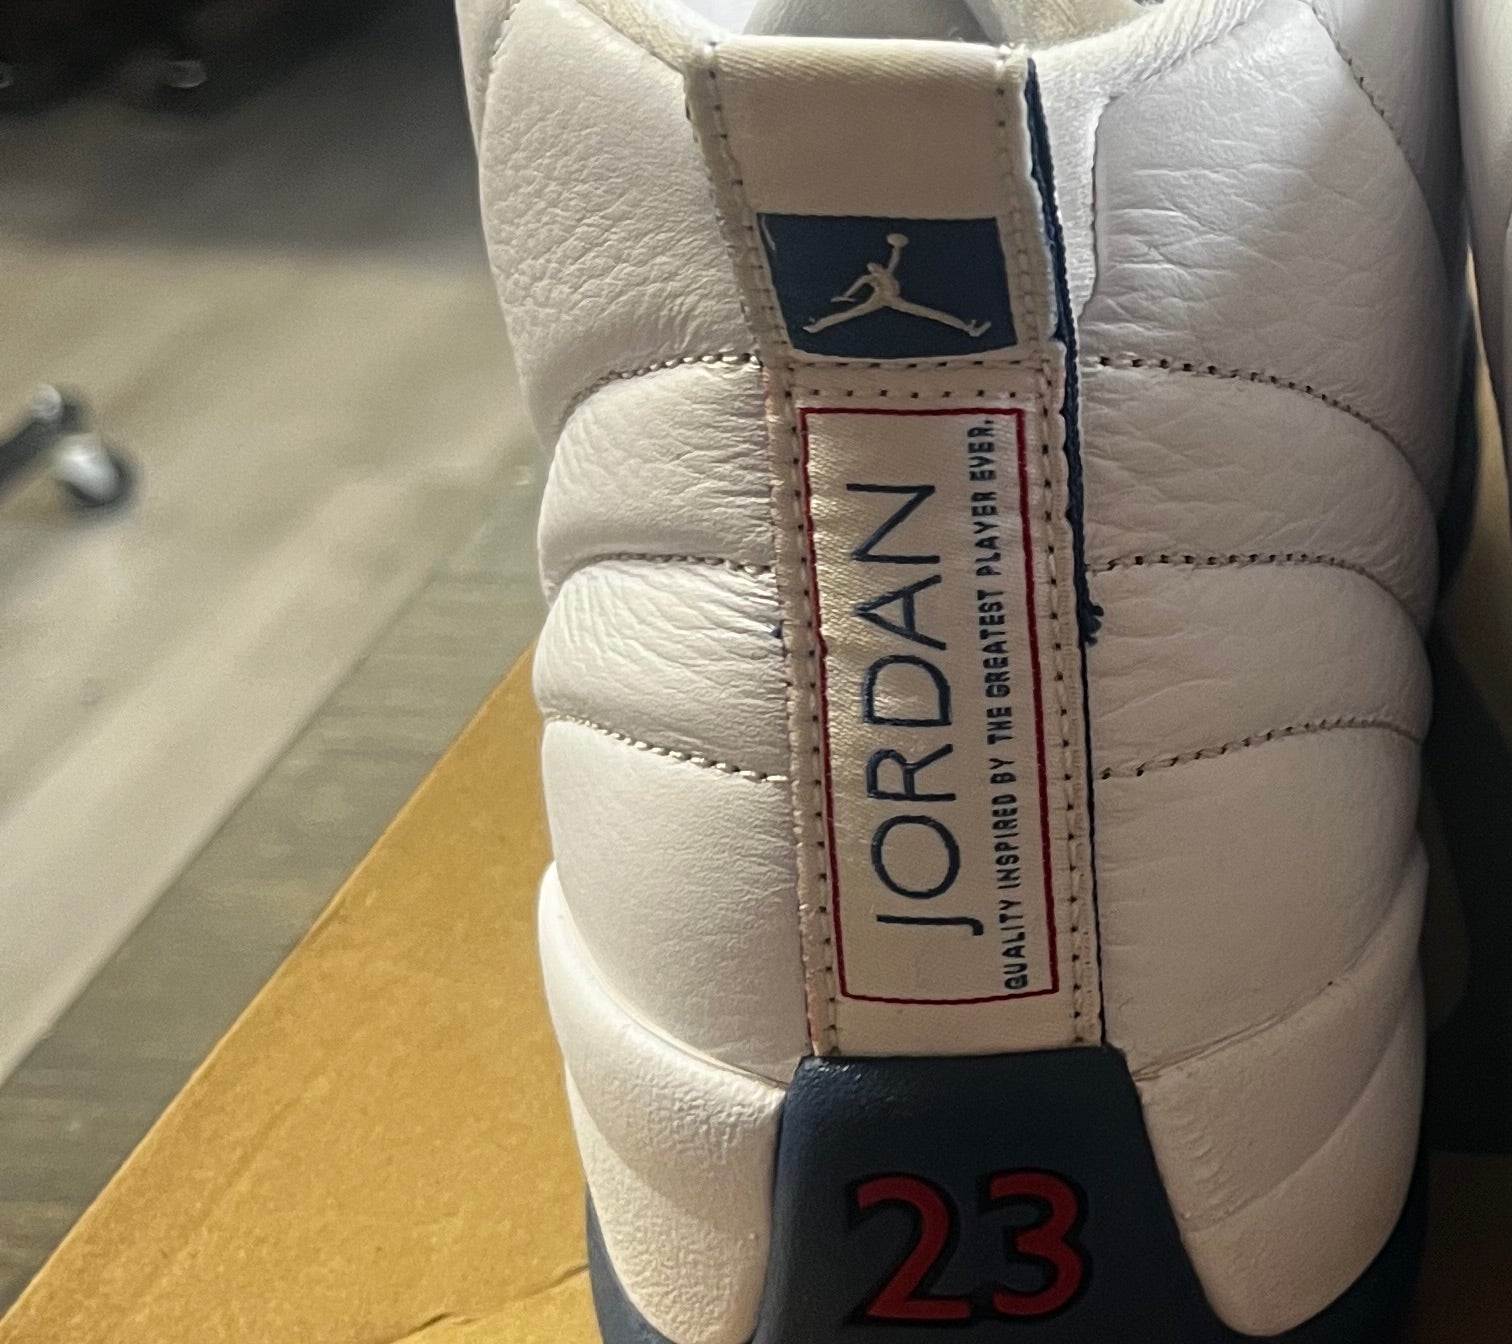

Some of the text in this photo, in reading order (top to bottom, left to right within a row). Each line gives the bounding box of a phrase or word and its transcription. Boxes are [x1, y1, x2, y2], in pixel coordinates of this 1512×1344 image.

[846, 483, 984, 937] JORDAN
[967, 419, 1028, 990] QUALITY INSPIRED BY THE GREATEST PLAYER EVER.
[850, 1168, 1090, 1324] 23
